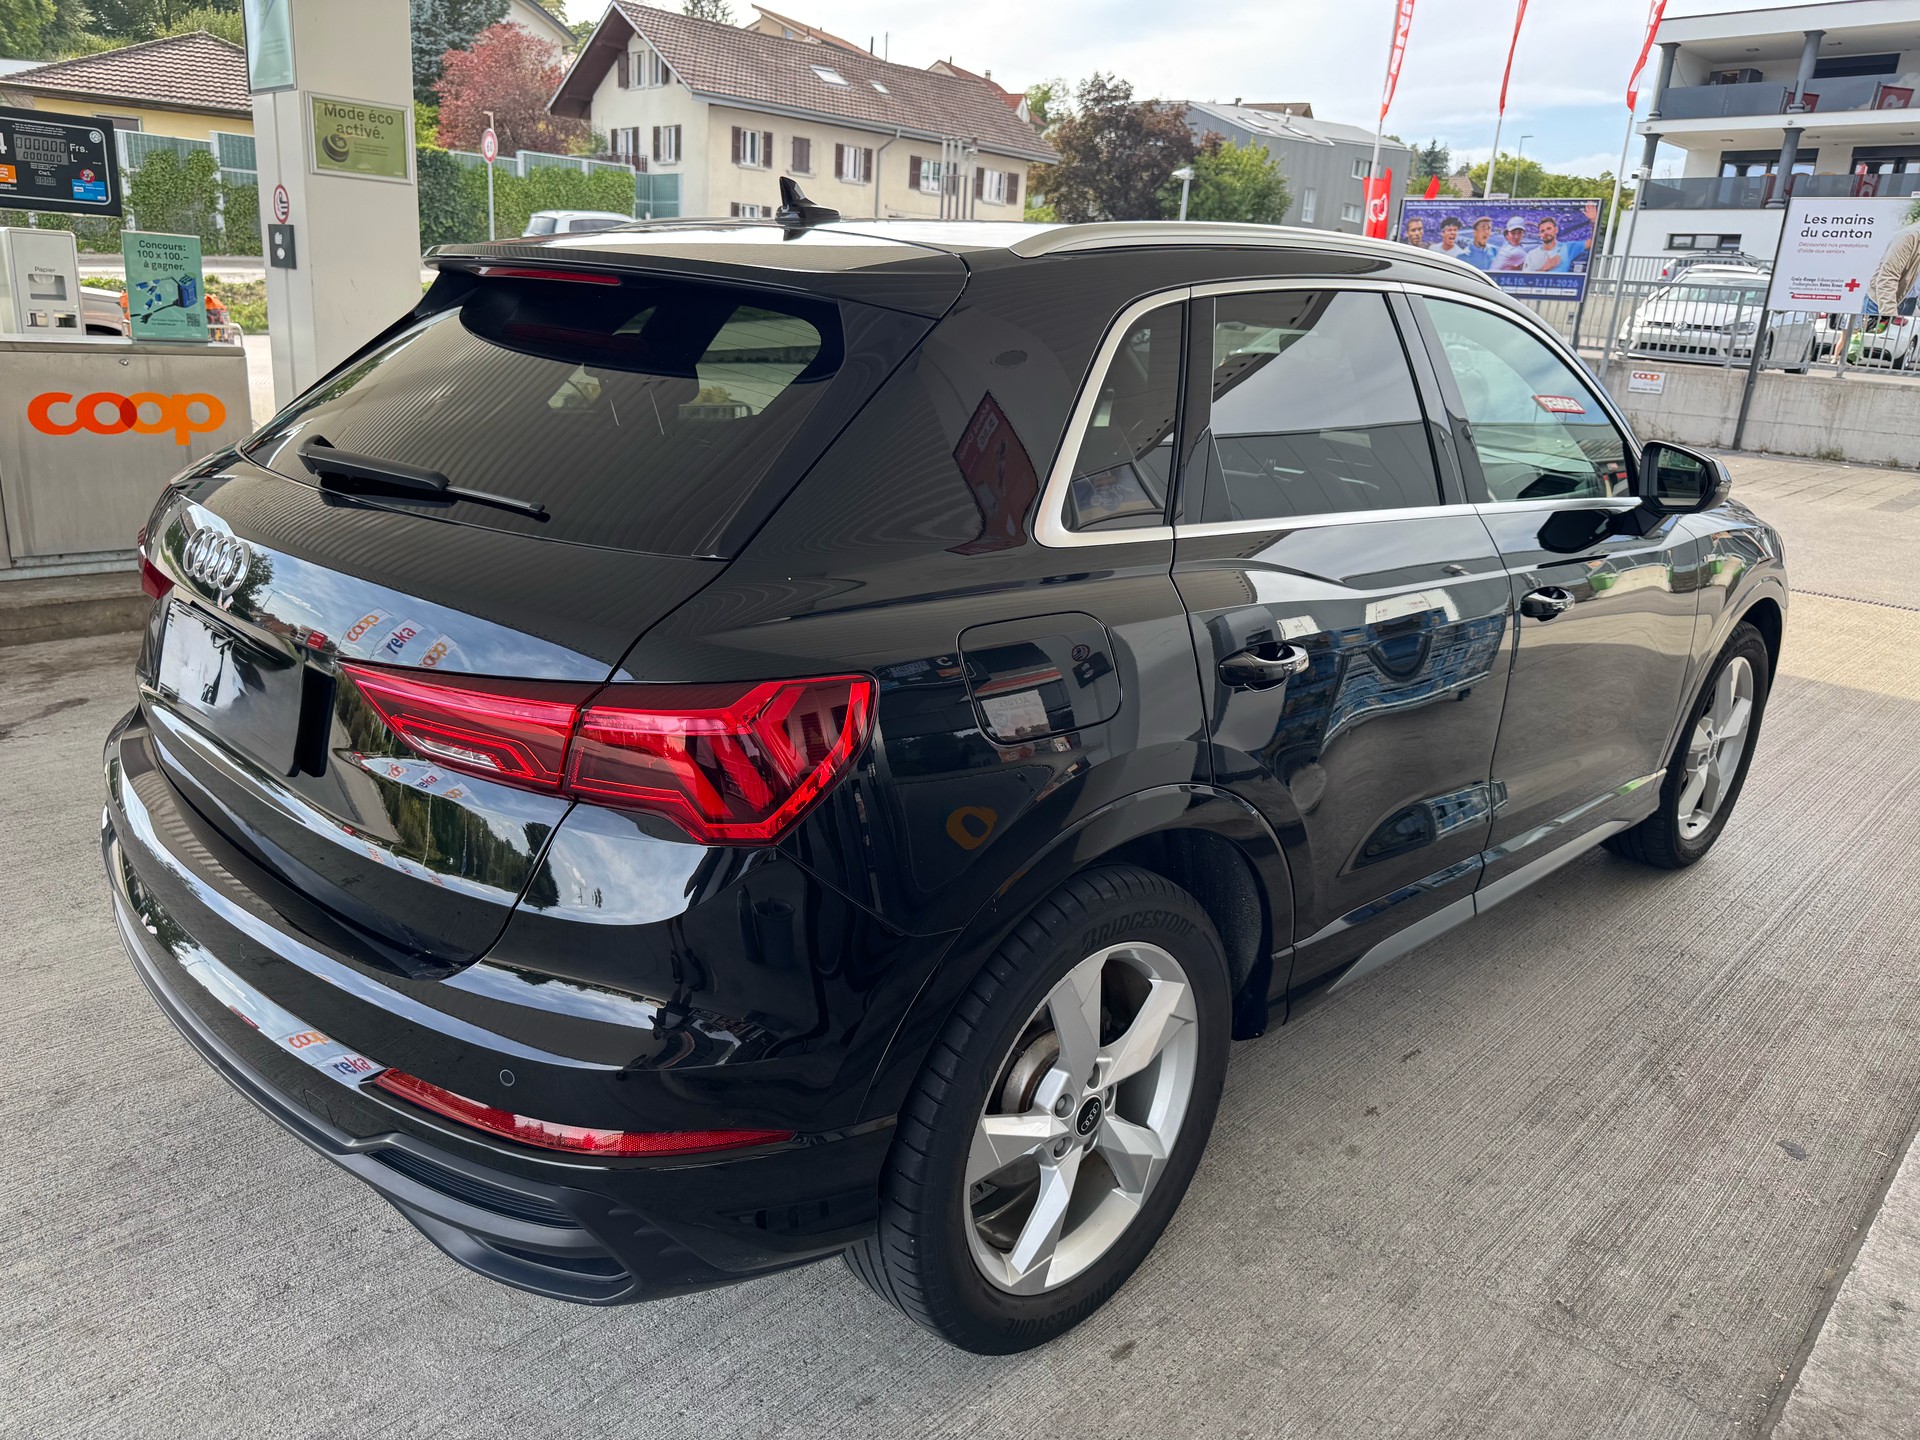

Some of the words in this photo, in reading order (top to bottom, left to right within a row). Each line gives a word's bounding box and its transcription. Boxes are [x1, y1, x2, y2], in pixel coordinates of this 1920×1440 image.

[324, 103, 365, 121] Mode
[368, 109, 394, 125] éco
[336, 123, 384, 140] activé.
[69, 143, 88, 153] Frs.
[71, 154, 77, 162] L
[1803, 213, 1827, 224] Les
[1831, 213, 1875, 225] mains
[1800, 227, 1818, 238] du
[1821, 229, 1873, 239] canton
[139, 240, 186, 251] Concours:
[137, 250, 154, 259] 100
[143, 260, 149, 268] à
[151, 262, 185, 271] gagner.
[1632, 372, 1660, 382] coop
[27, 391, 226, 446] coop
[346, 614, 379, 642] coop
[386, 627, 416, 655] reka
[419, 642, 447, 667] oop
[416, 775, 438, 788] eka
[1081, 909, 1197, 955] BRIDGESTONE
[332, 1056, 372, 1075] reka
